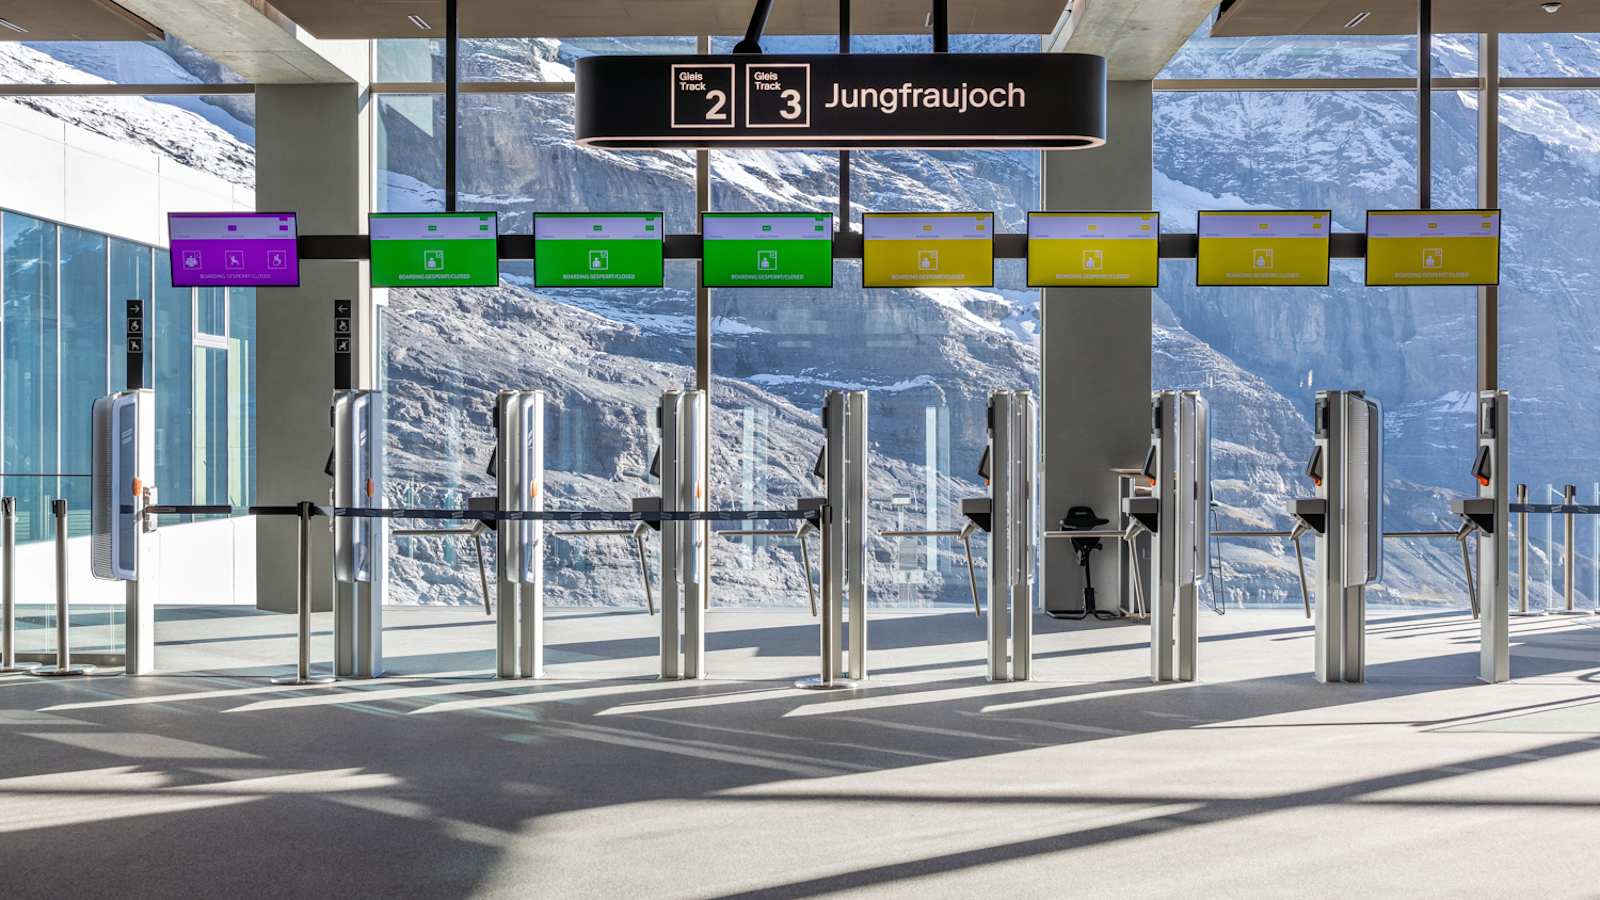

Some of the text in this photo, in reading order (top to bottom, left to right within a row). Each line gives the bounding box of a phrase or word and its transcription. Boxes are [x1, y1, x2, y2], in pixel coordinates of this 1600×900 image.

[679, 71, 703, 81] Gleis
[754, 71, 778, 81] Gleis
[679, 81, 706, 91] Track
[754, 81, 781, 91] Track
[825, 82, 1025, 114] Jungfraujoch
[705, 89, 727, 120] 2
[779, 88, 802, 120] 3
